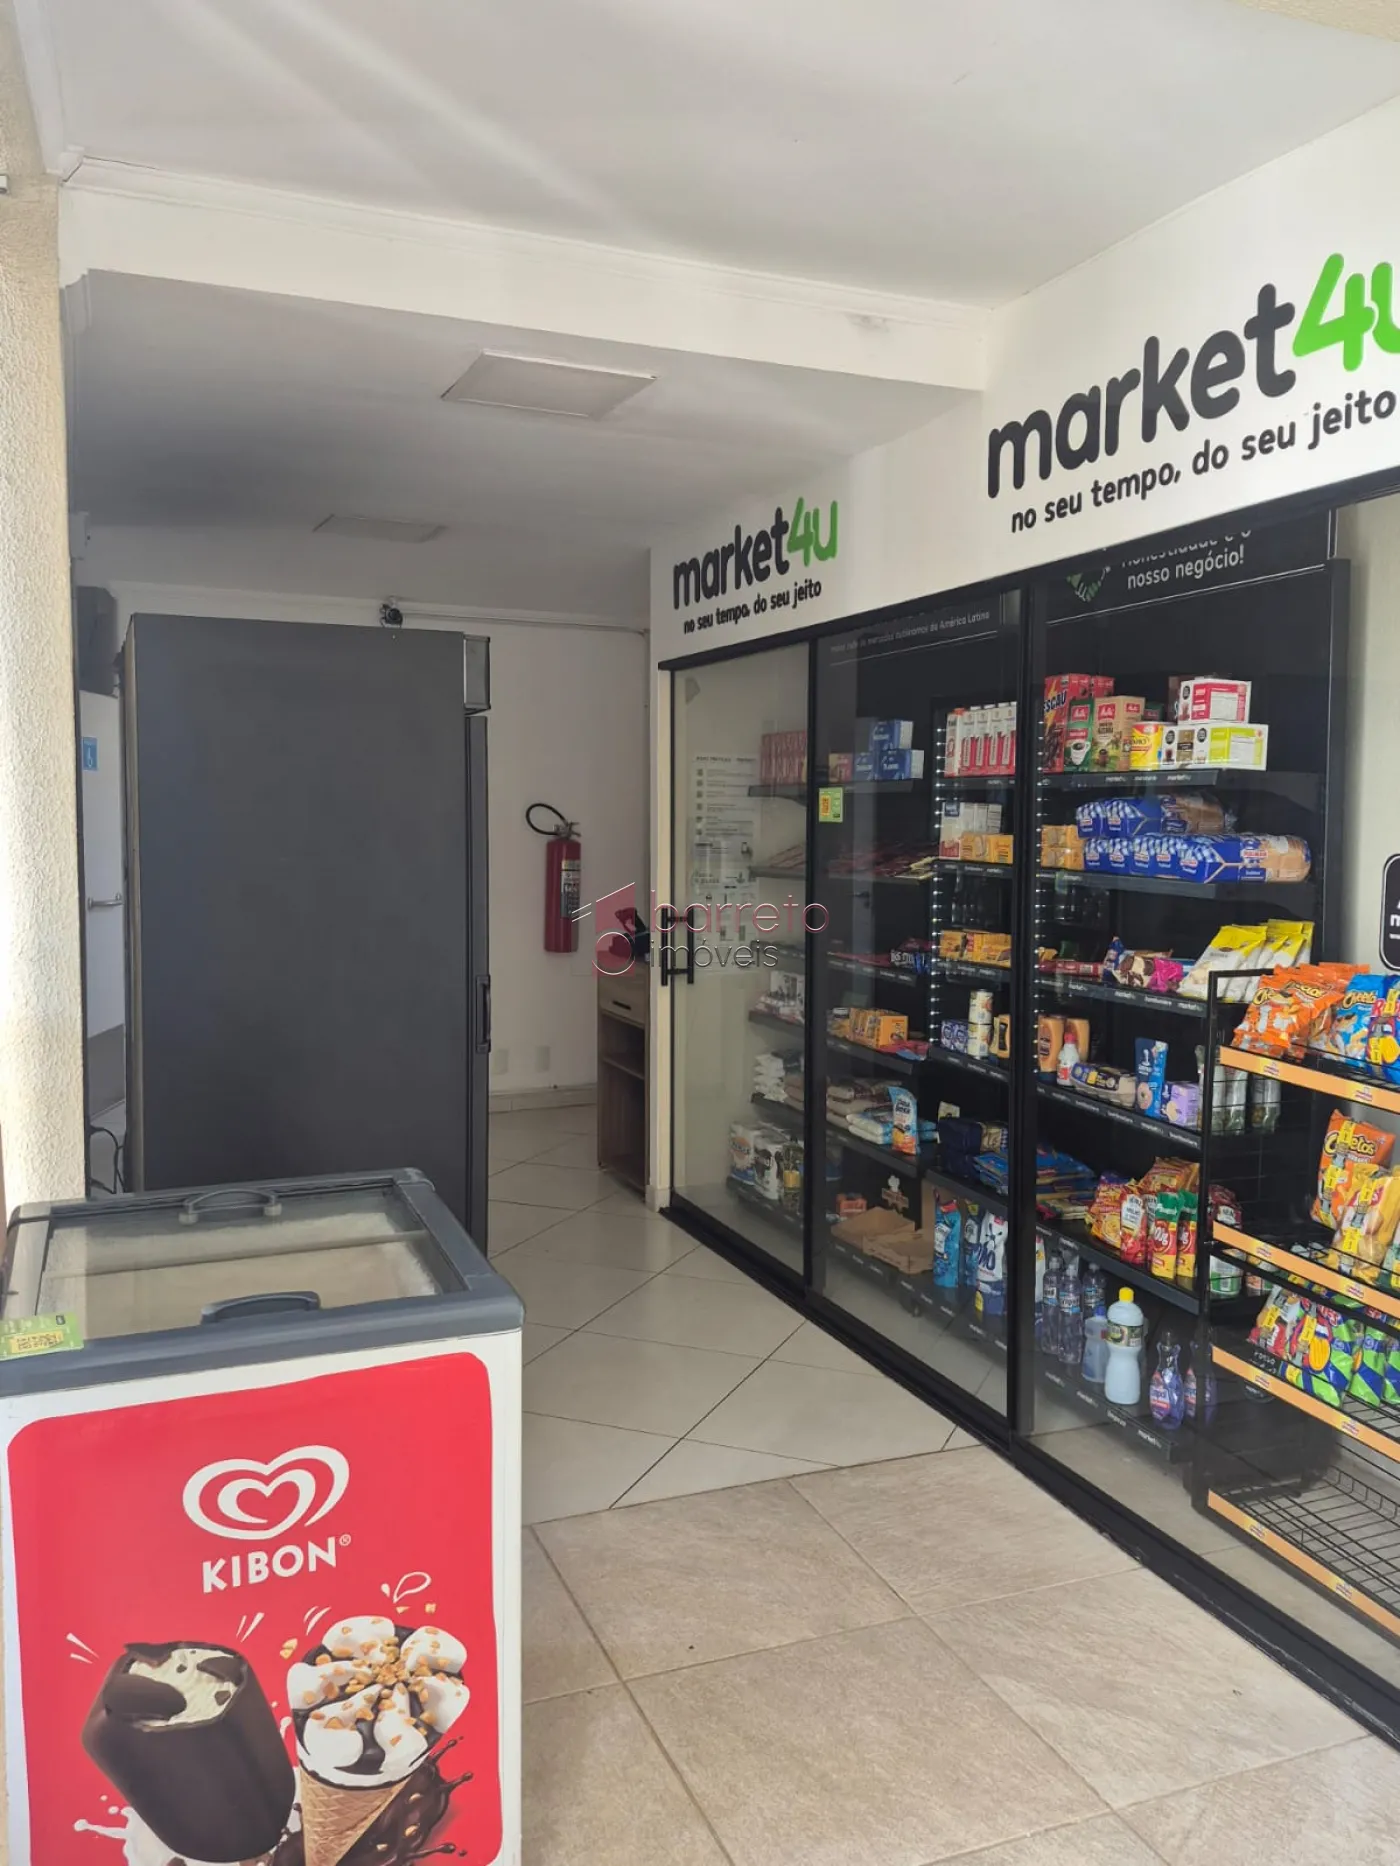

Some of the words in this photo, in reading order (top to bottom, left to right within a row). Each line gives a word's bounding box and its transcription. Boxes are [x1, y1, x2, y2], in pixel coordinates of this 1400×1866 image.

[1011, 508, 1037, 533] no
[1044, 490, 1083, 524] seu
[1090, 462, 1182, 507] tempo,
[1192, 438, 1230, 475] do
[1241, 421, 1297, 461] seu
[1307, 389, 1398, 450] jeito
[1126, 564, 1170, 591] nosso
[1175, 543, 1246, 579] negócio!
[683, 618, 696, 635] no
[697, 612, 714, 631] seu
[753, 592, 768, 614] do
[769, 589, 791, 610] seu
[791, 578, 822, 609] jeito
[202, 1536, 337, 1594] KIBON
